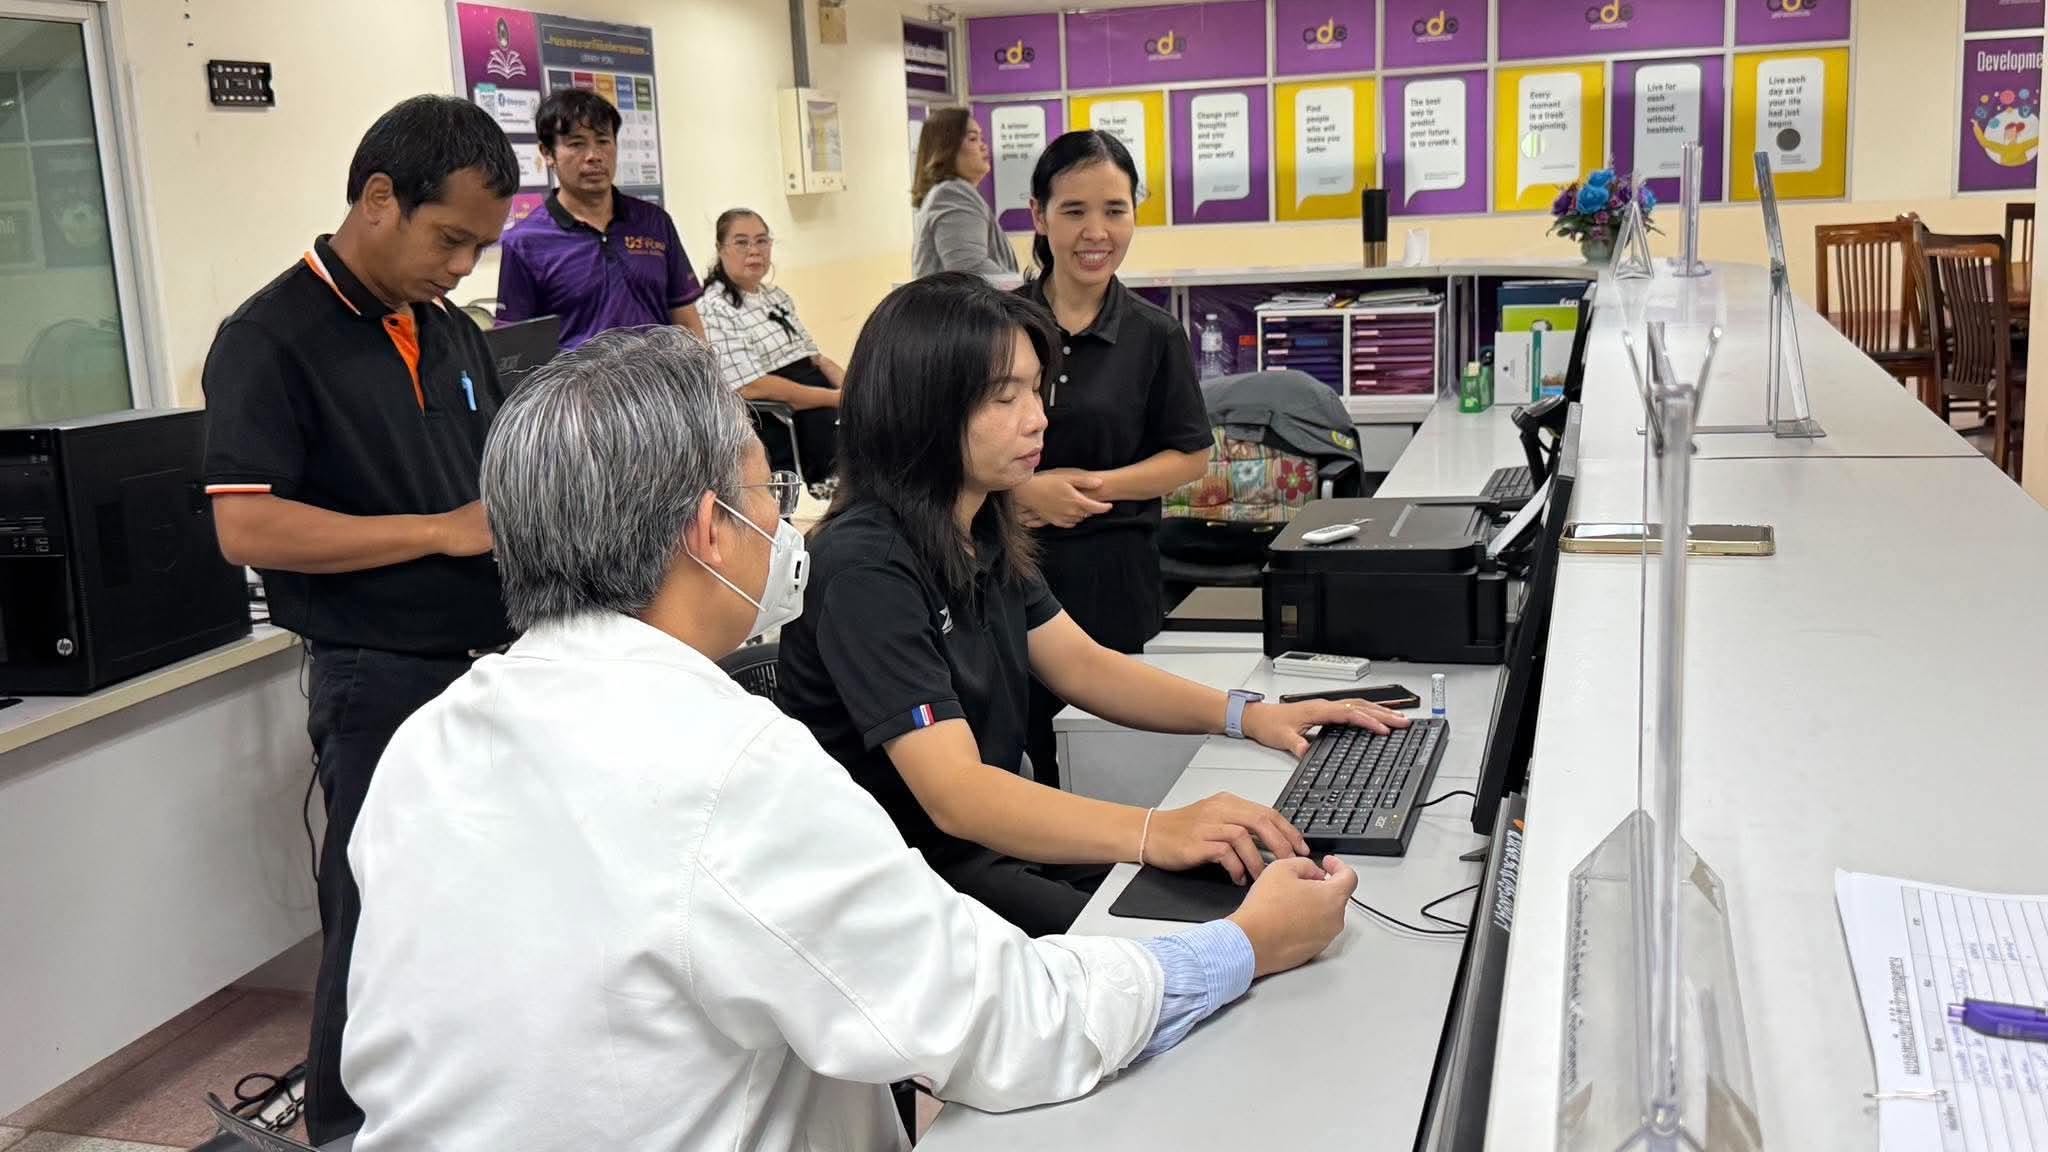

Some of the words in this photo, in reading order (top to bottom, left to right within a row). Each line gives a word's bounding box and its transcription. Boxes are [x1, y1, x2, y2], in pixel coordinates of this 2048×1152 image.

[1769, 76, 1785, 85] Live
[1788, 75, 1806, 83] each
[1647, 84, 1662, 92] Live
[1768, 88, 1783, 96] day
[1530, 91, 1551, 99] Every
[1411, 98, 1423, 106] The
[1425, 97, 1440, 105] best
[1530, 101, 1560, 109] moment
[1768, 99, 1786, 107] your
[1197, 111, 1222, 120] Change
[1545, 112, 1564, 120] fresh
[1768, 109, 1783, 117] had
[1785, 108, 1800, 118] just
